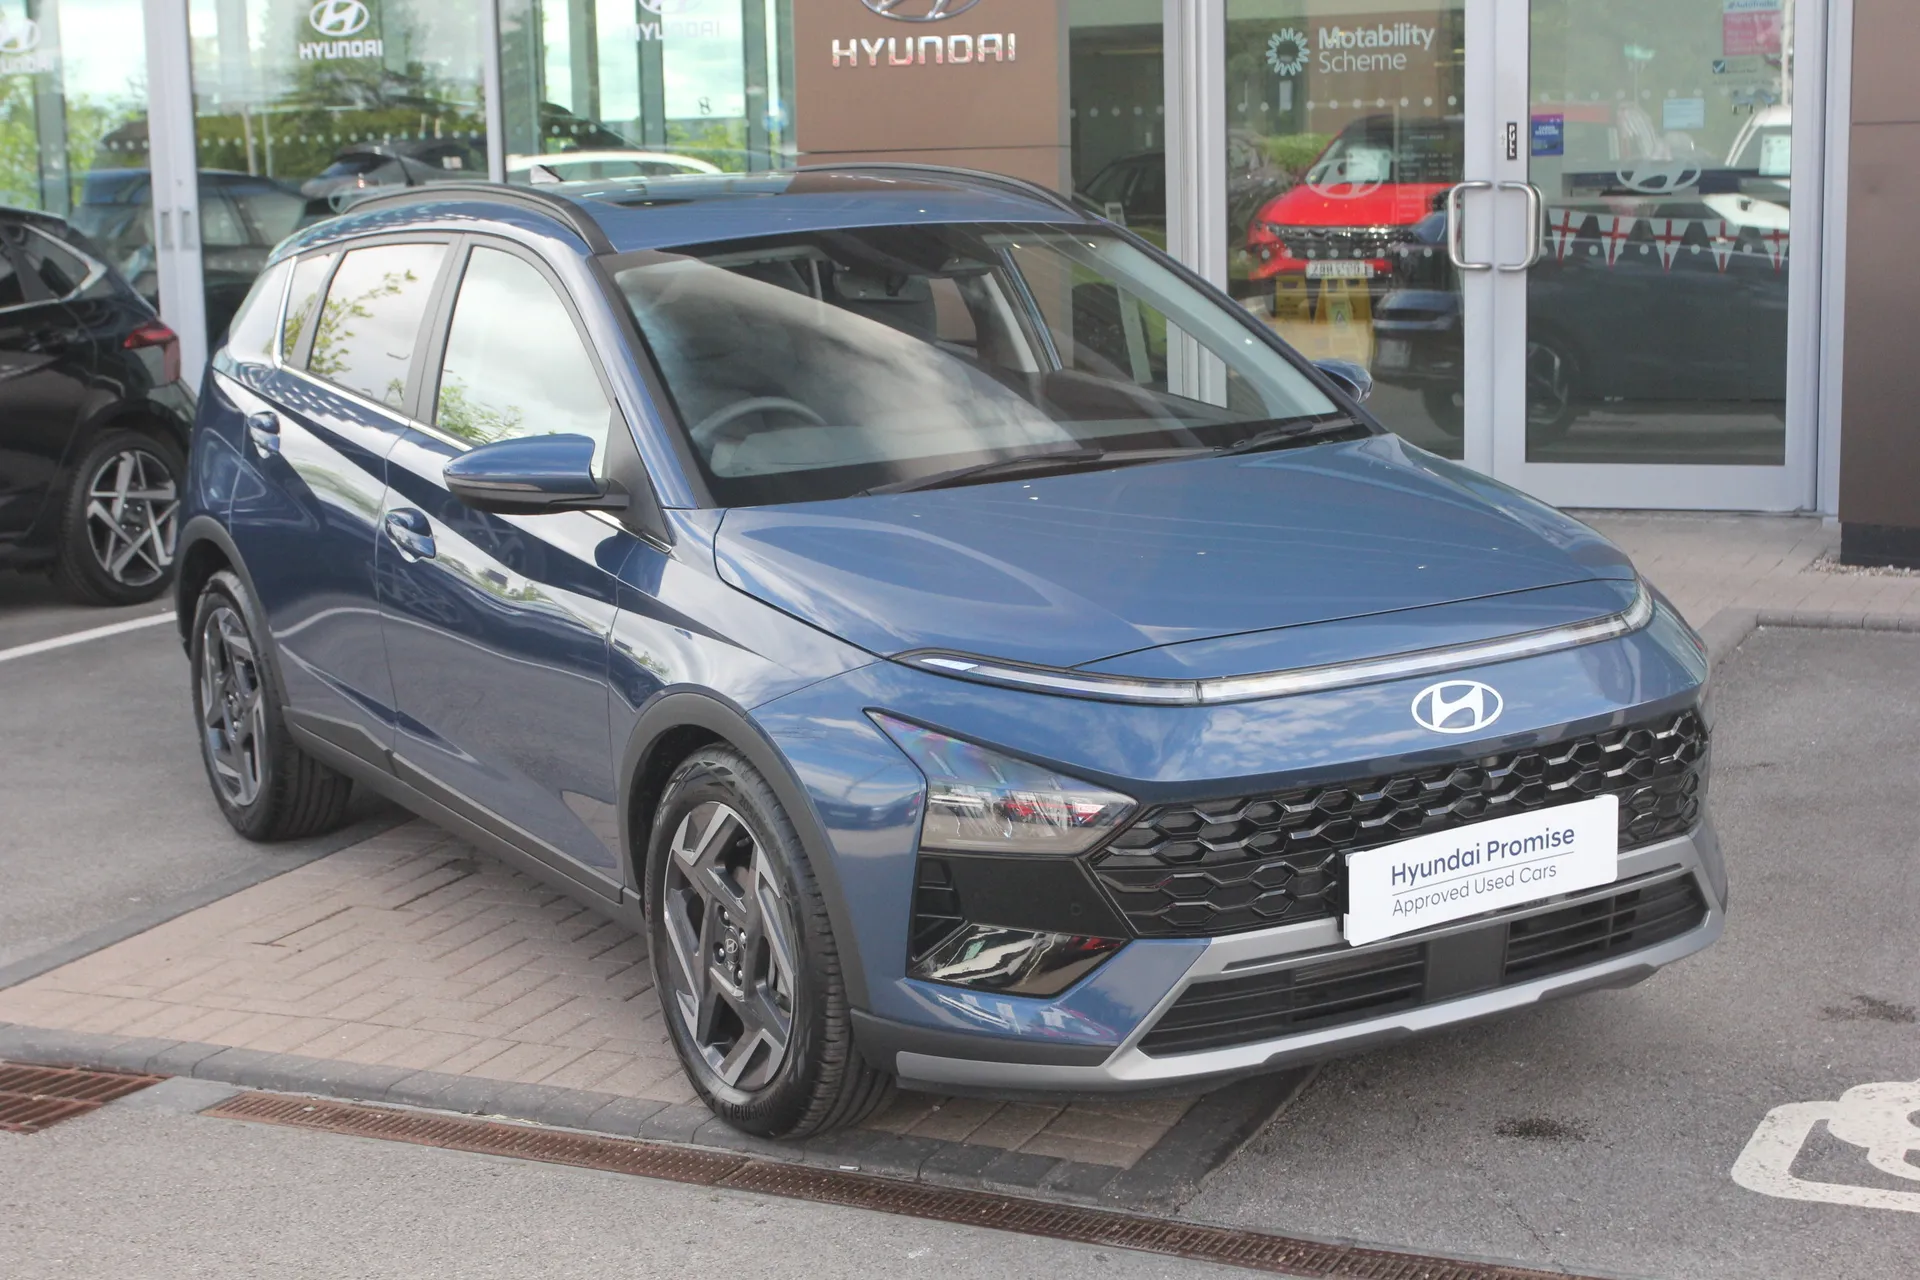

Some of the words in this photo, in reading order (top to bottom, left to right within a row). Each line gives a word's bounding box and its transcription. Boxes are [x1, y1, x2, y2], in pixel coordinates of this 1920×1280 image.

[299, 38, 384, 60] HYUNDAI
[832, 33, 1016, 68] HYUNDAI
[1318, 22, 1436, 51] Motability
[1318, 50, 1408, 74] Scheme
[1391, 842, 1481, 887] Hyundai
[1486, 826, 1575, 863] Promise
[1392, 880, 1470, 917] Approved
[1475, 870, 1515, 895] Used
[1519, 863, 1557, 884] Cars
